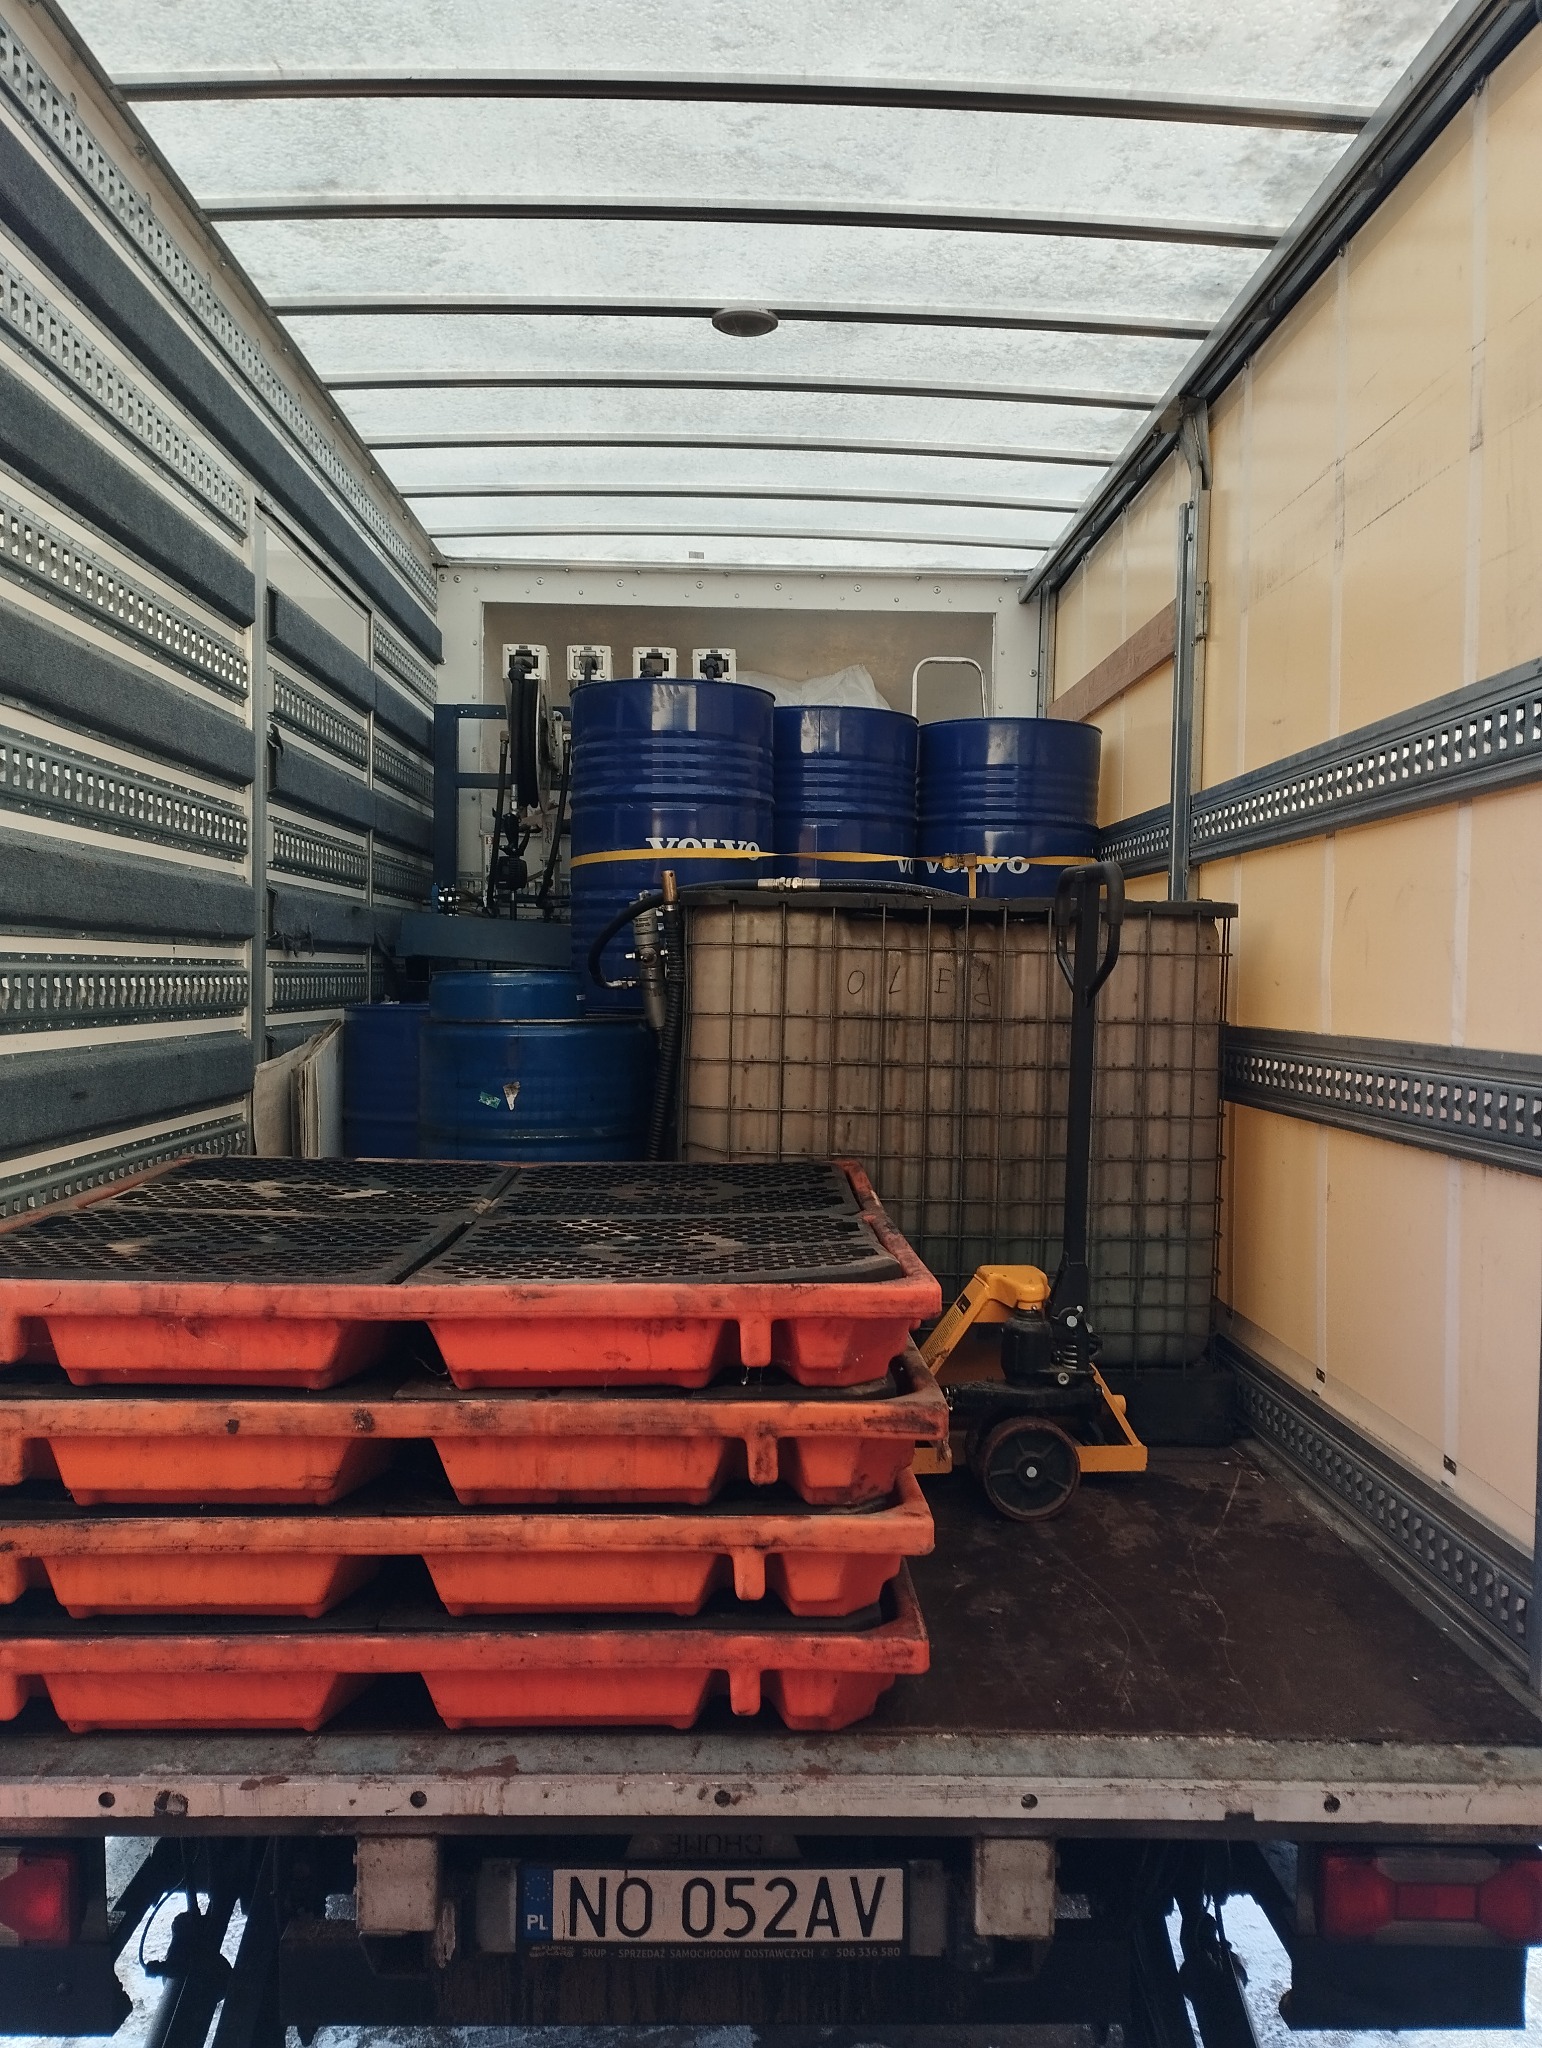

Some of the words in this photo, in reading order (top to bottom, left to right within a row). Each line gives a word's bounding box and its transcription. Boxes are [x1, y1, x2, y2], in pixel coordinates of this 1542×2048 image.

[926, 856, 1030, 874] VVO
[569, 1876, 653, 1938] NO
[681, 1876, 886, 1938] 052AV
[527, 1914, 548, 1930] PL
[582, 1948, 607, 1958] SKUP
[618, 1947, 666, 1958] SPRZEDAŻ
[670, 1947, 741, 1958] SAMOCHODÓW
[744, 1948, 814, 1958] DOSTAWCZYCH
[836, 1948, 855, 1957] 506
[858, 1948, 878, 1957] 336
[880, 1948, 901, 1957] 580
